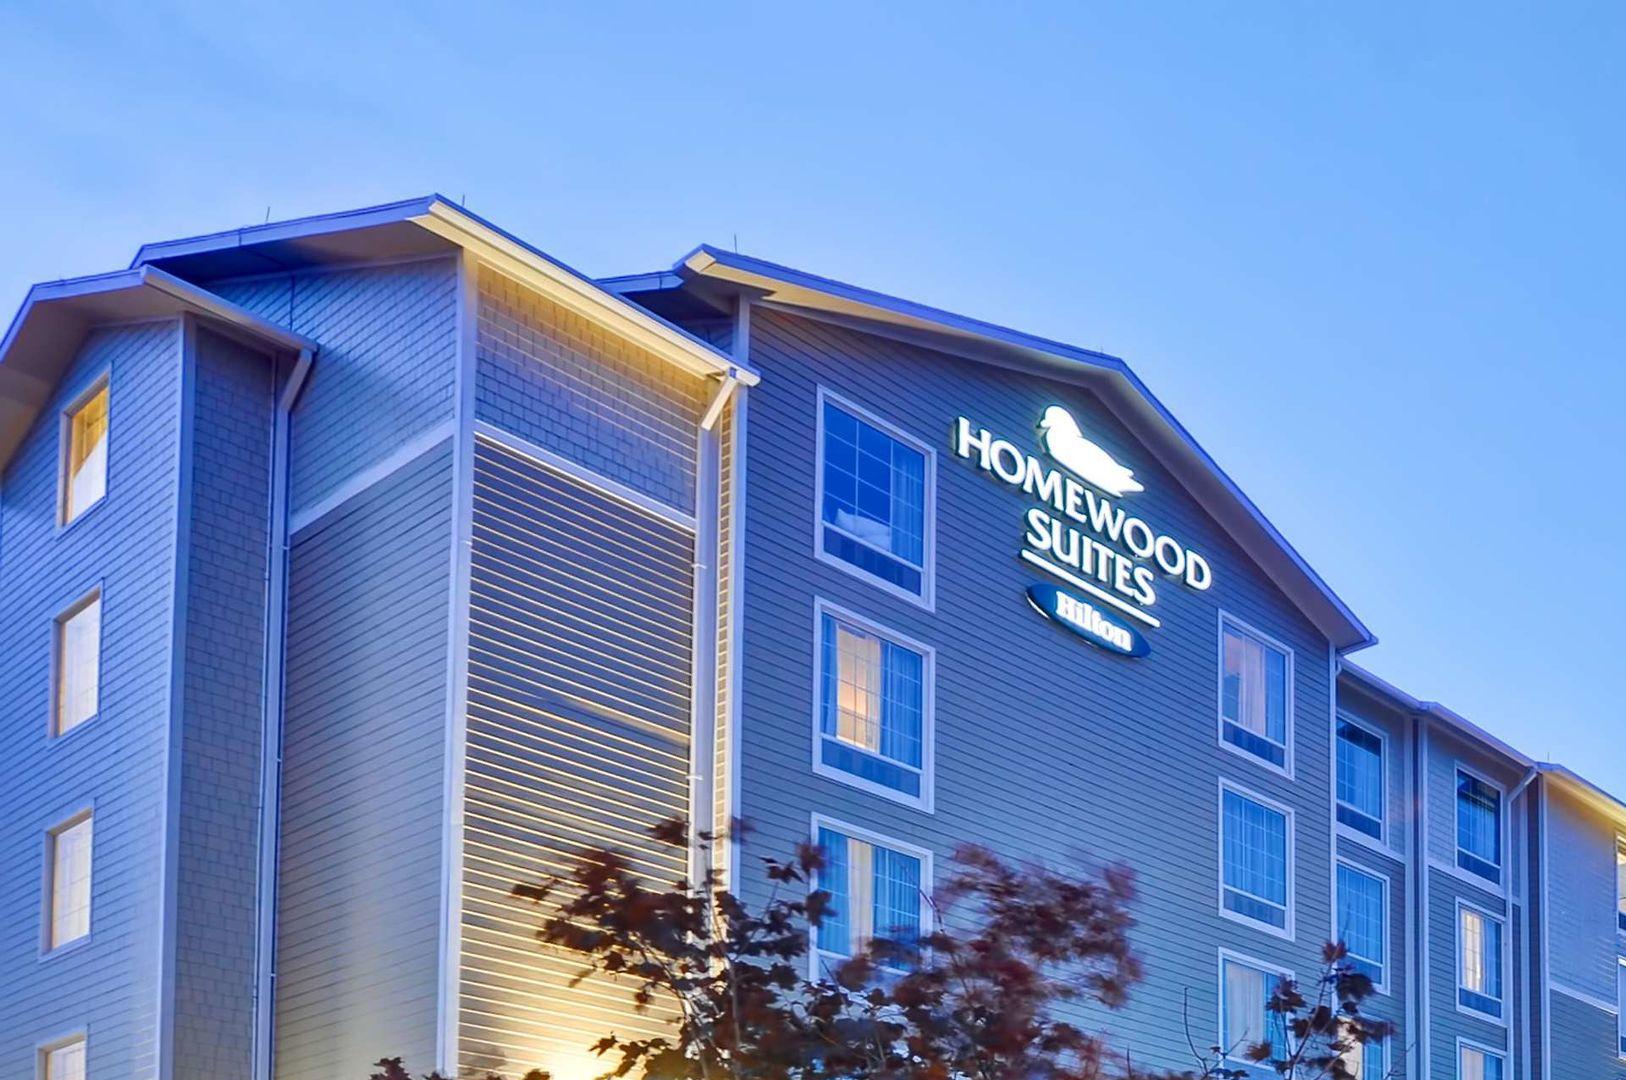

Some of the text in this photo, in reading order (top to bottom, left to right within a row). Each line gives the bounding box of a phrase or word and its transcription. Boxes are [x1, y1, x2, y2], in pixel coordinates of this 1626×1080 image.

[956, 416, 1212, 591] HOMEWOOD
[1026, 508, 1156, 606] SUITES
[1055, 590, 1133, 652] Hilton
